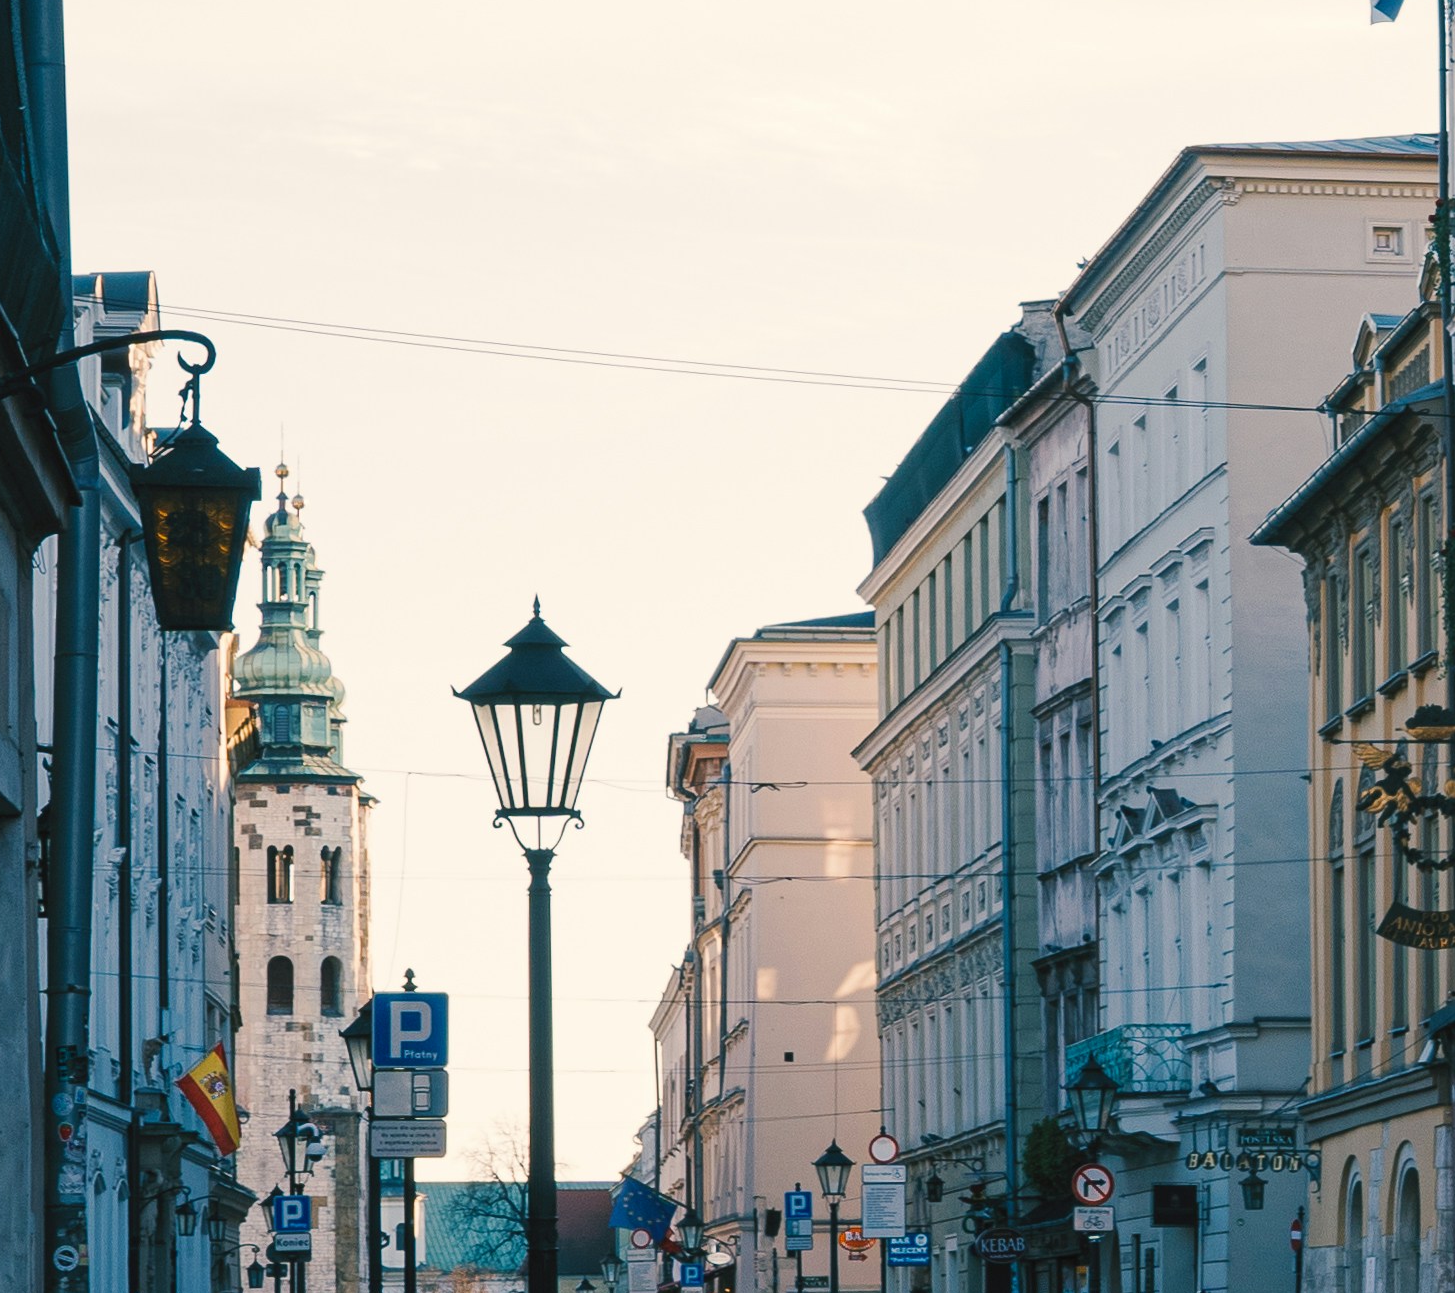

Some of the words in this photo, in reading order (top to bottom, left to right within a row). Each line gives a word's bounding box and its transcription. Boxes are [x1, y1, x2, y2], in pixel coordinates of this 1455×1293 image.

[390, 1000, 432, 1059] P
[403, 1049, 438, 1061] Płatny
[1188, 1151, 1300, 1171] BALATON
[283, 1200, 302, 1228] P
[791, 1195, 805, 1215] P
[276, 1238, 309, 1247] Koniec
[981, 1237, 1025, 1252] KEBAB
[686, 1267, 698, 1283] P
